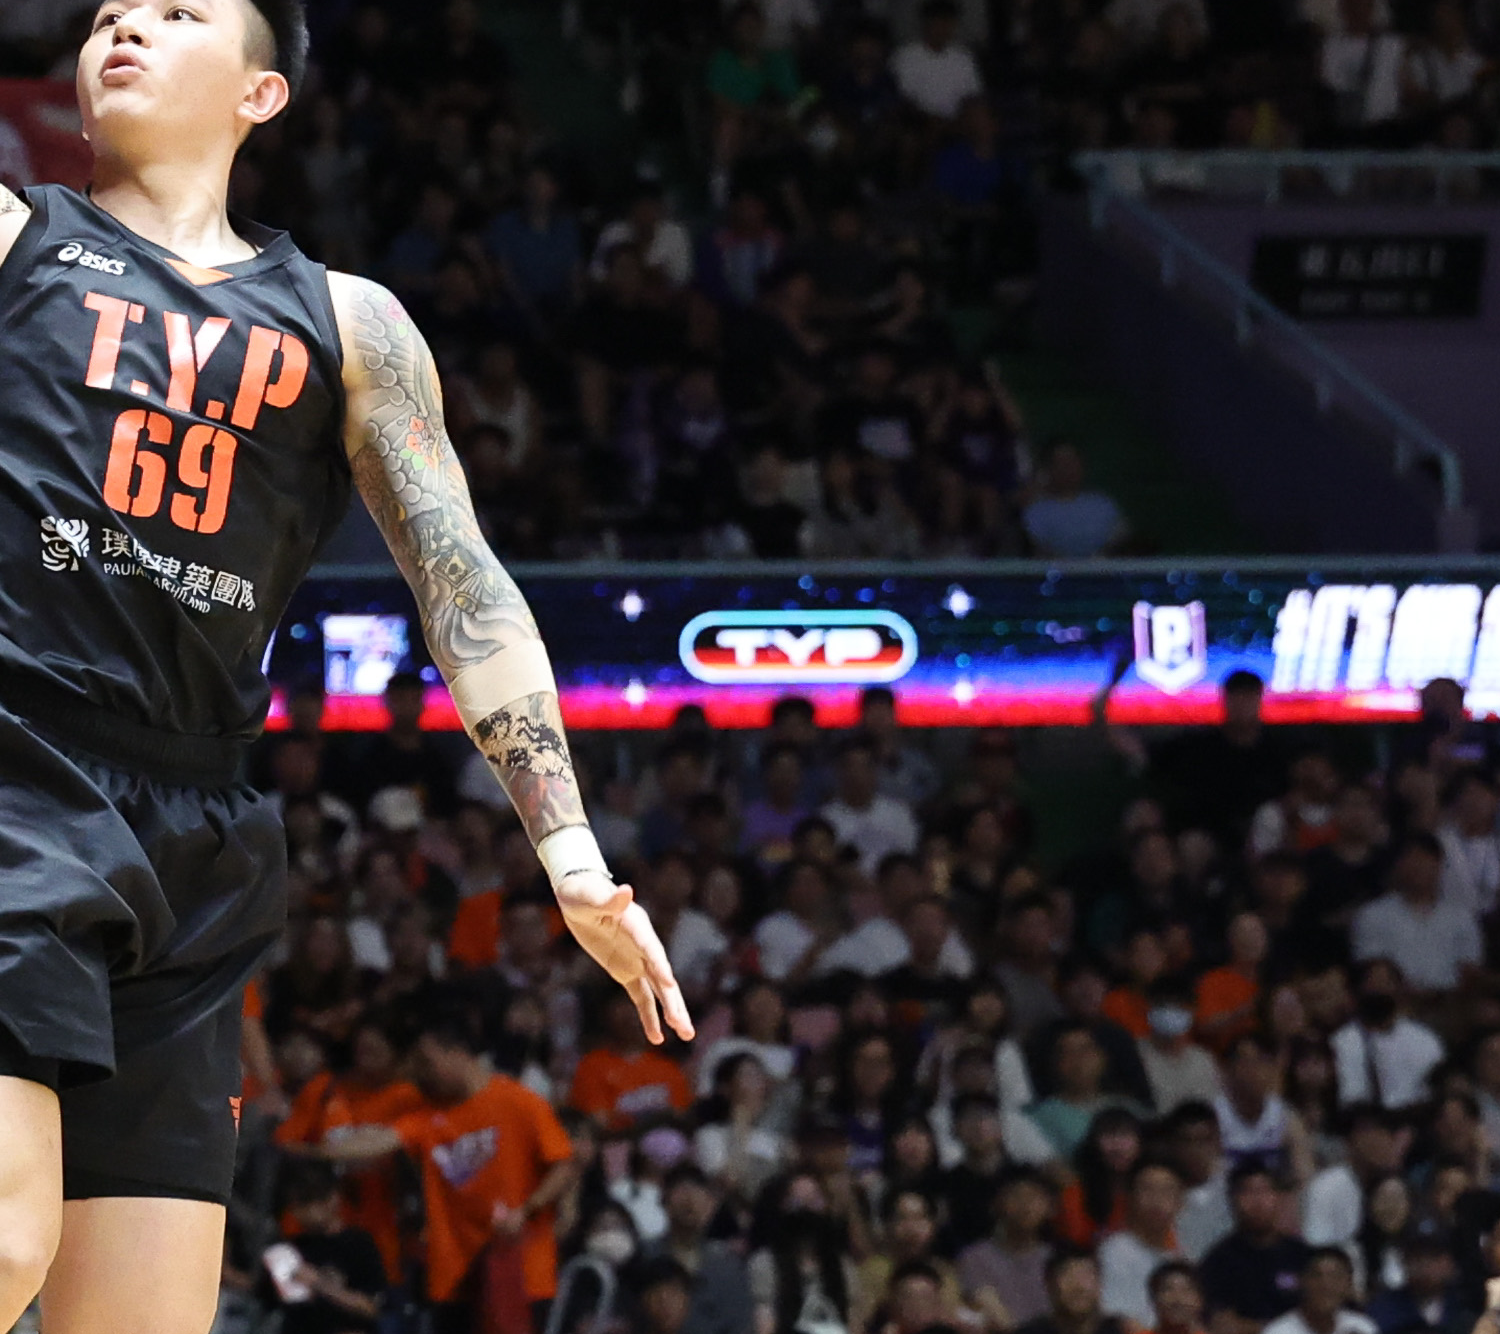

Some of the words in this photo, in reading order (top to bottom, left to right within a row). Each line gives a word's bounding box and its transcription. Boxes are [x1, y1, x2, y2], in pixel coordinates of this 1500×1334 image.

[79, 249, 127, 276] asics
[83, 290, 311, 431] T.Y.P
[103, 408, 239, 535] 69
[716, 628, 883, 667] TYP
